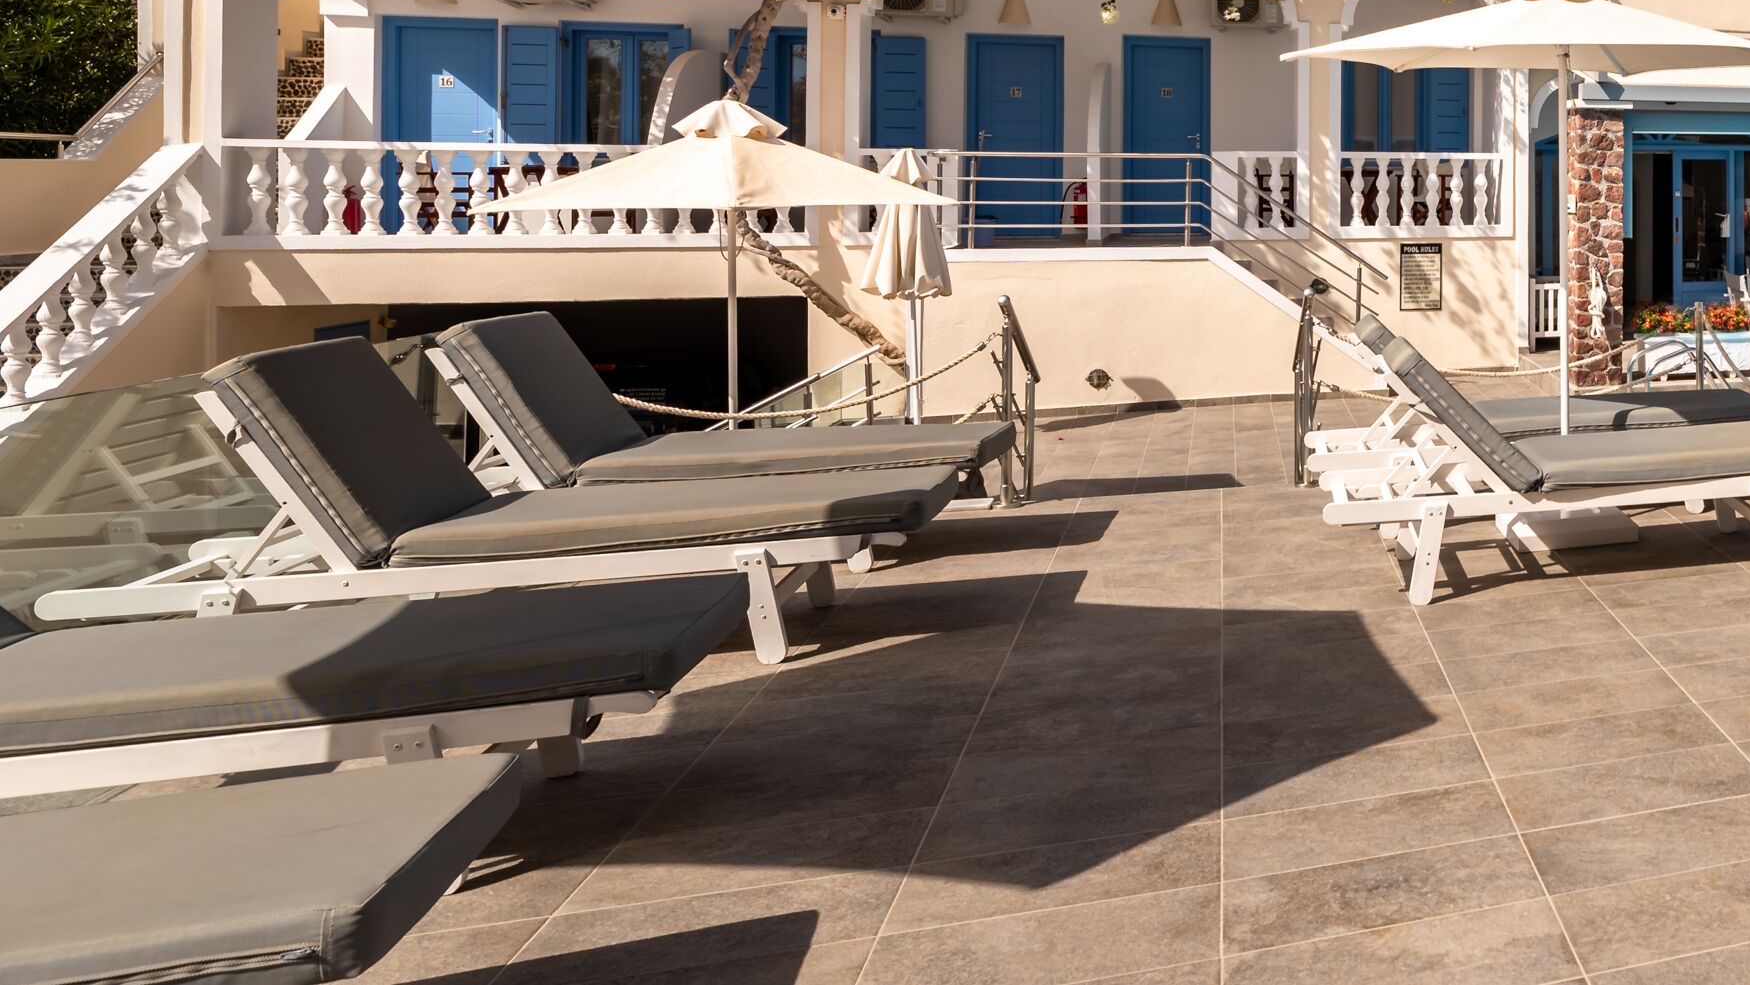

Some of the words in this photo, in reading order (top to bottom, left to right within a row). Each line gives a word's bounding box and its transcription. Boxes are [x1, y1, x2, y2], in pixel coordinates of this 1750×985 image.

[441, 77, 453, 86] 16
[1012, 88, 1021, 96] 17
[1163, 88, 1172, 96] 18
